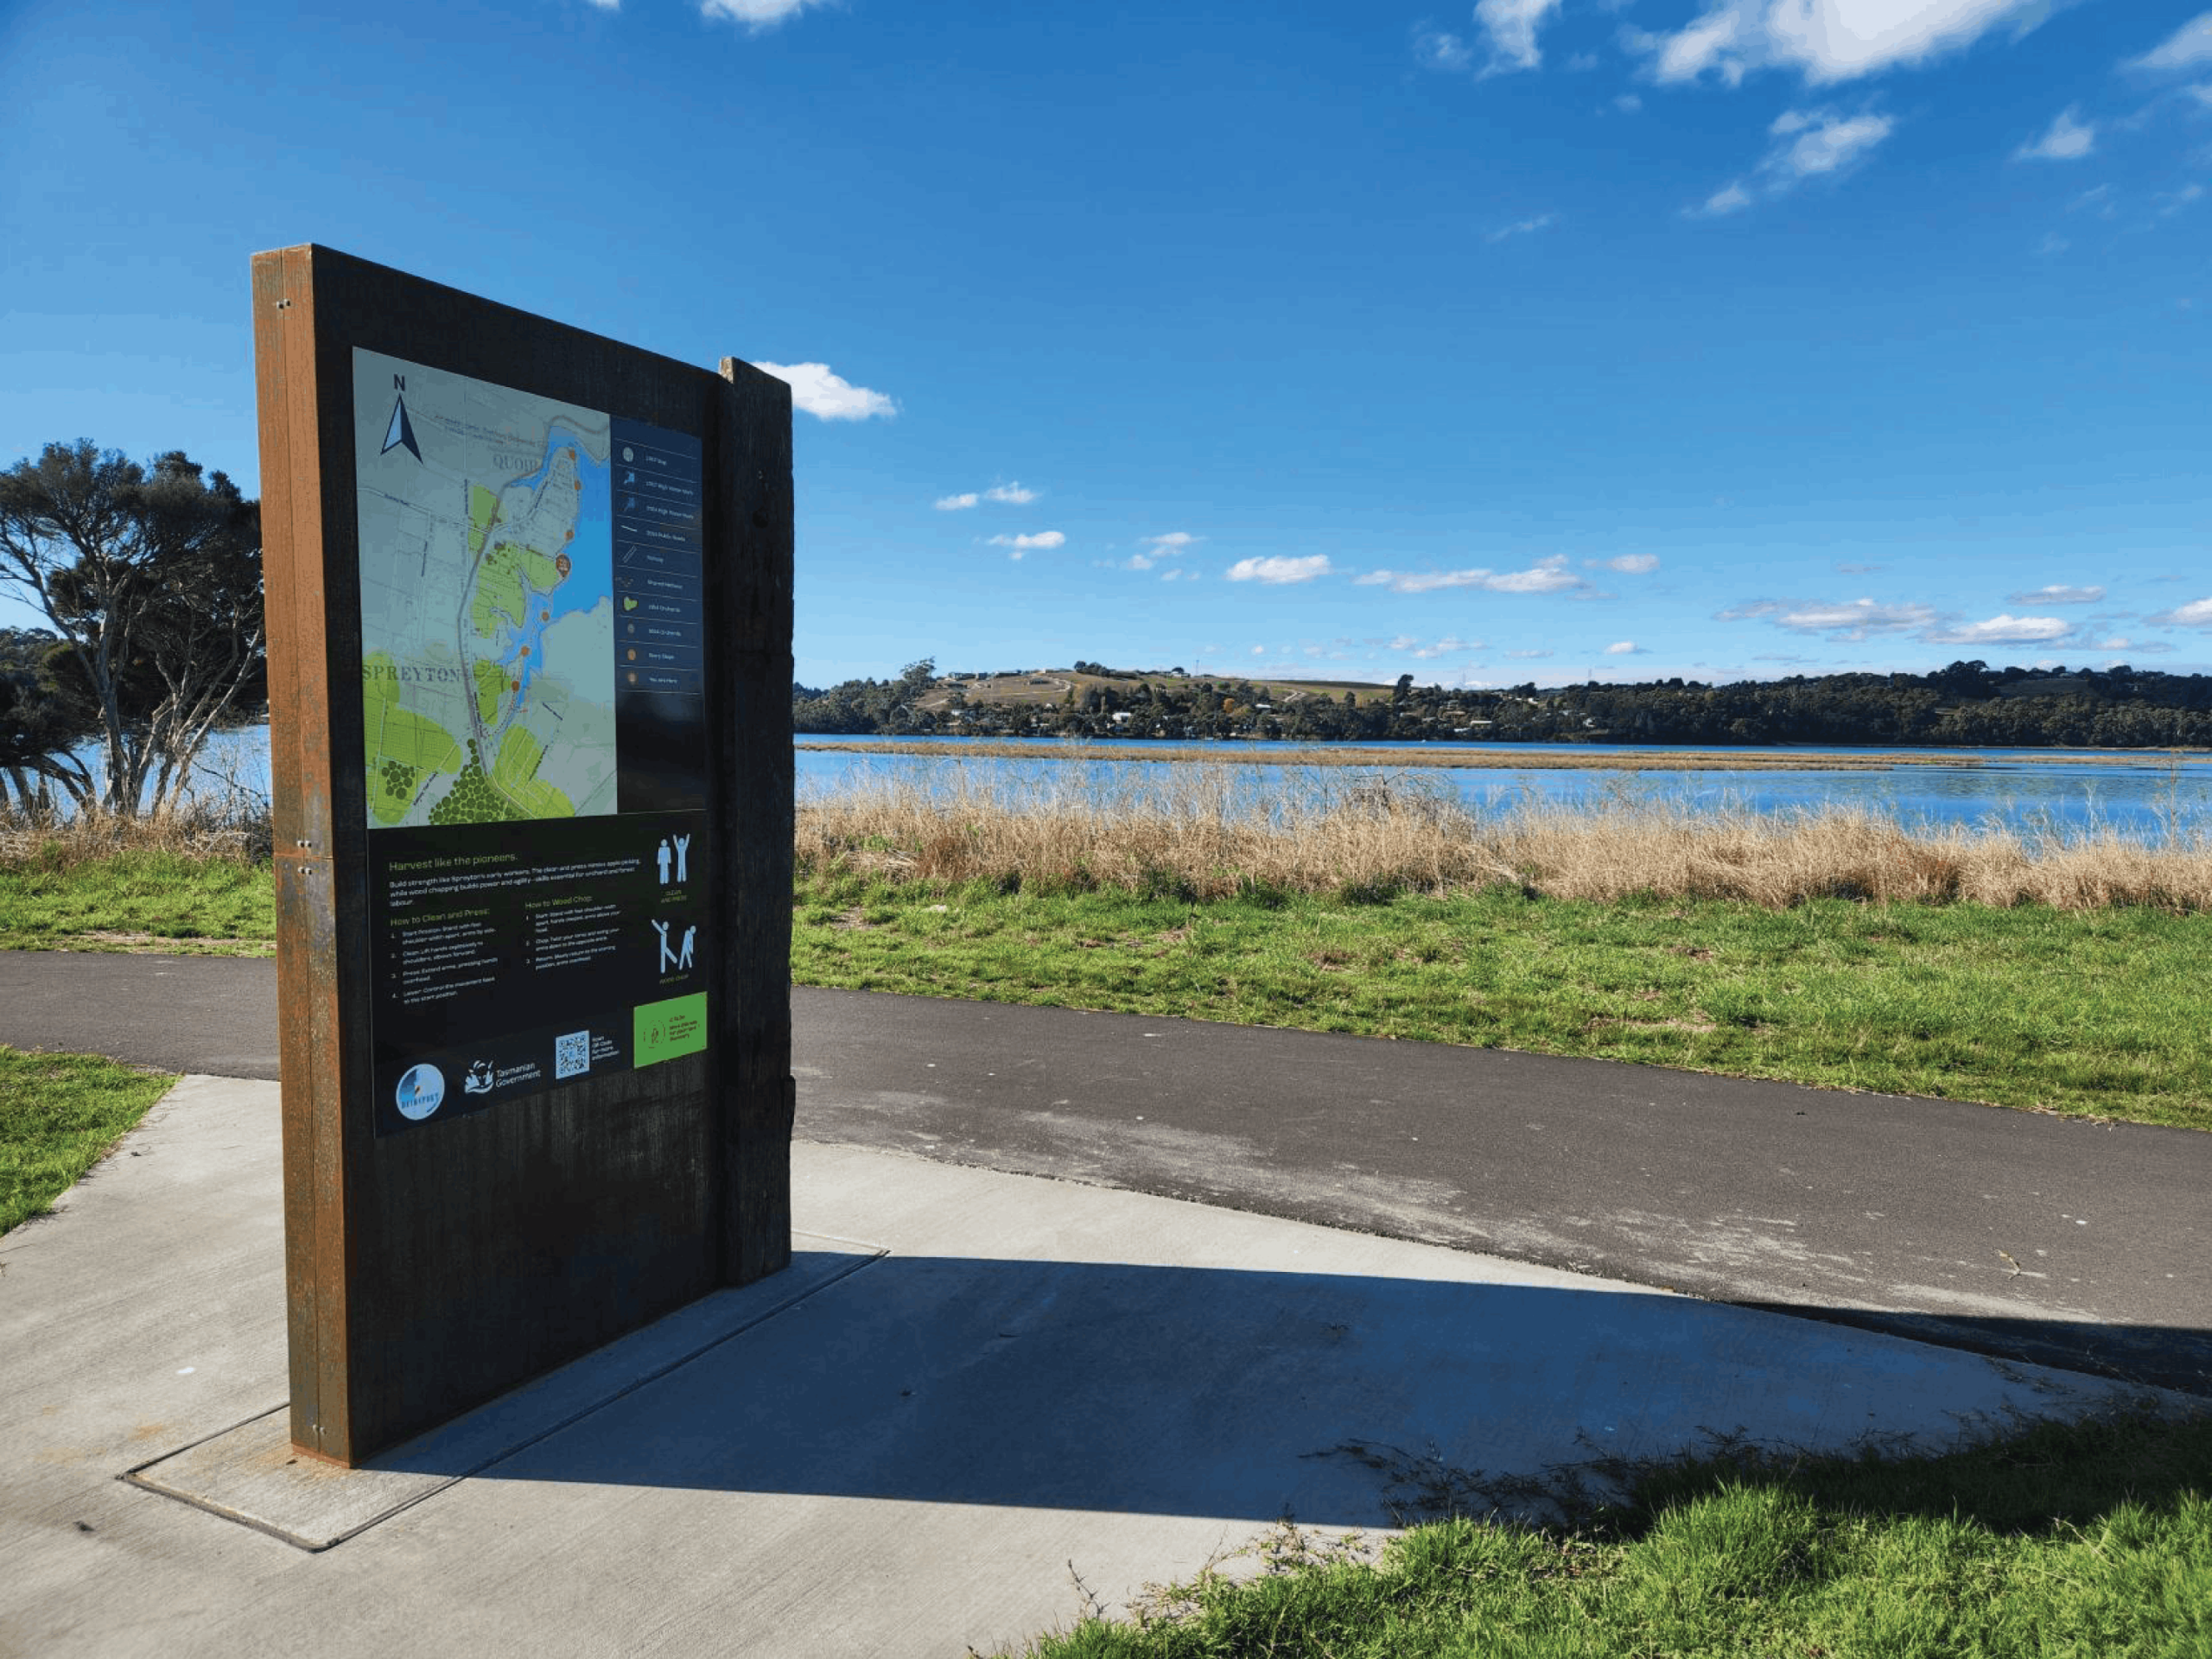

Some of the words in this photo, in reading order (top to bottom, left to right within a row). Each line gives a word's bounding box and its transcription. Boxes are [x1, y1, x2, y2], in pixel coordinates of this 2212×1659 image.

[394, 373, 405, 391] N
[362, 664, 461, 682] SPREYTON
[389, 861, 432, 871] Harvest
[435, 858, 452, 868] like
[454, 856, 470, 866] the
[473, 854, 518, 867] pioneers.
[408, 878, 438, 887] strength
[429, 885, 459, 893] chopping
[525, 901, 542, 910] How
[552, 898, 573, 906] Wood
[391, 918, 410, 926] How
[423, 913, 446, 923] Clean
[448, 911, 463, 919] and
[497, 1062, 536, 1078] Tasmanian
[495, 1069, 541, 1088] Government
